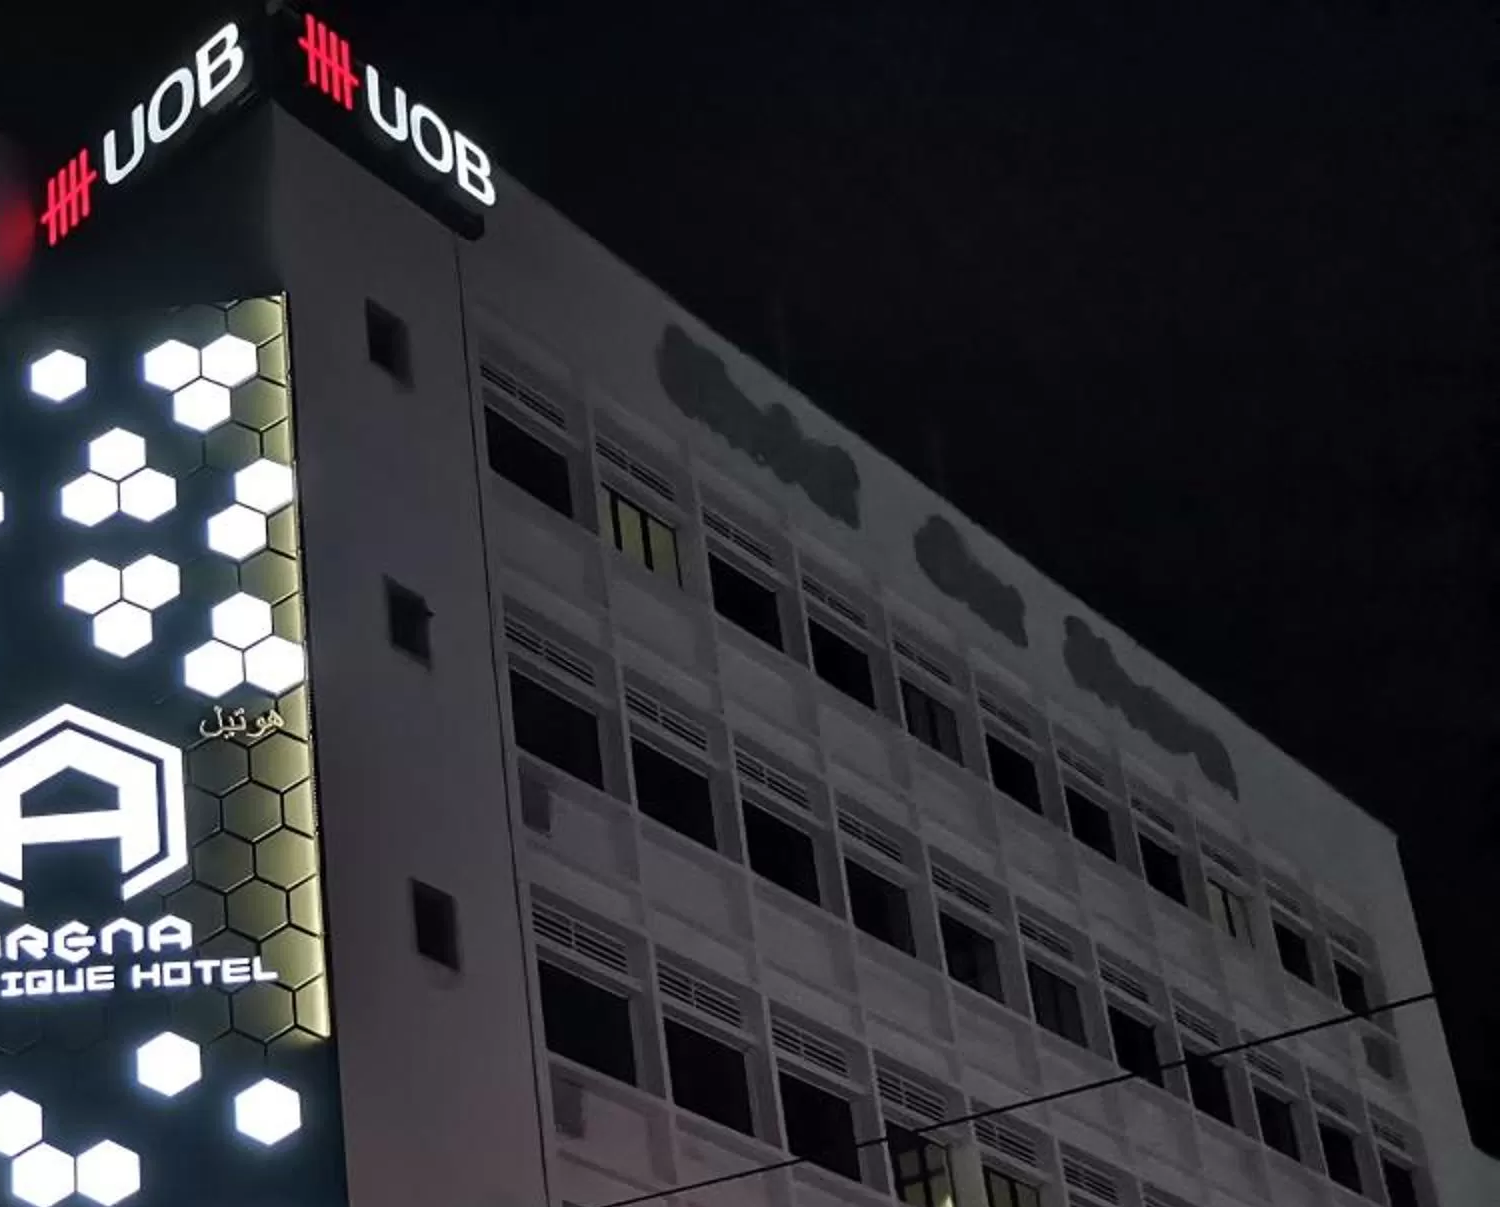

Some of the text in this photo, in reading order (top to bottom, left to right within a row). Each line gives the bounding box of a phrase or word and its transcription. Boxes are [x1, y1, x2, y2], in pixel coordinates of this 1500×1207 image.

[103, 22, 244, 185] UOB
[366, 64, 496, 206] UOB
[131, 956, 279, 990] HOTEL
